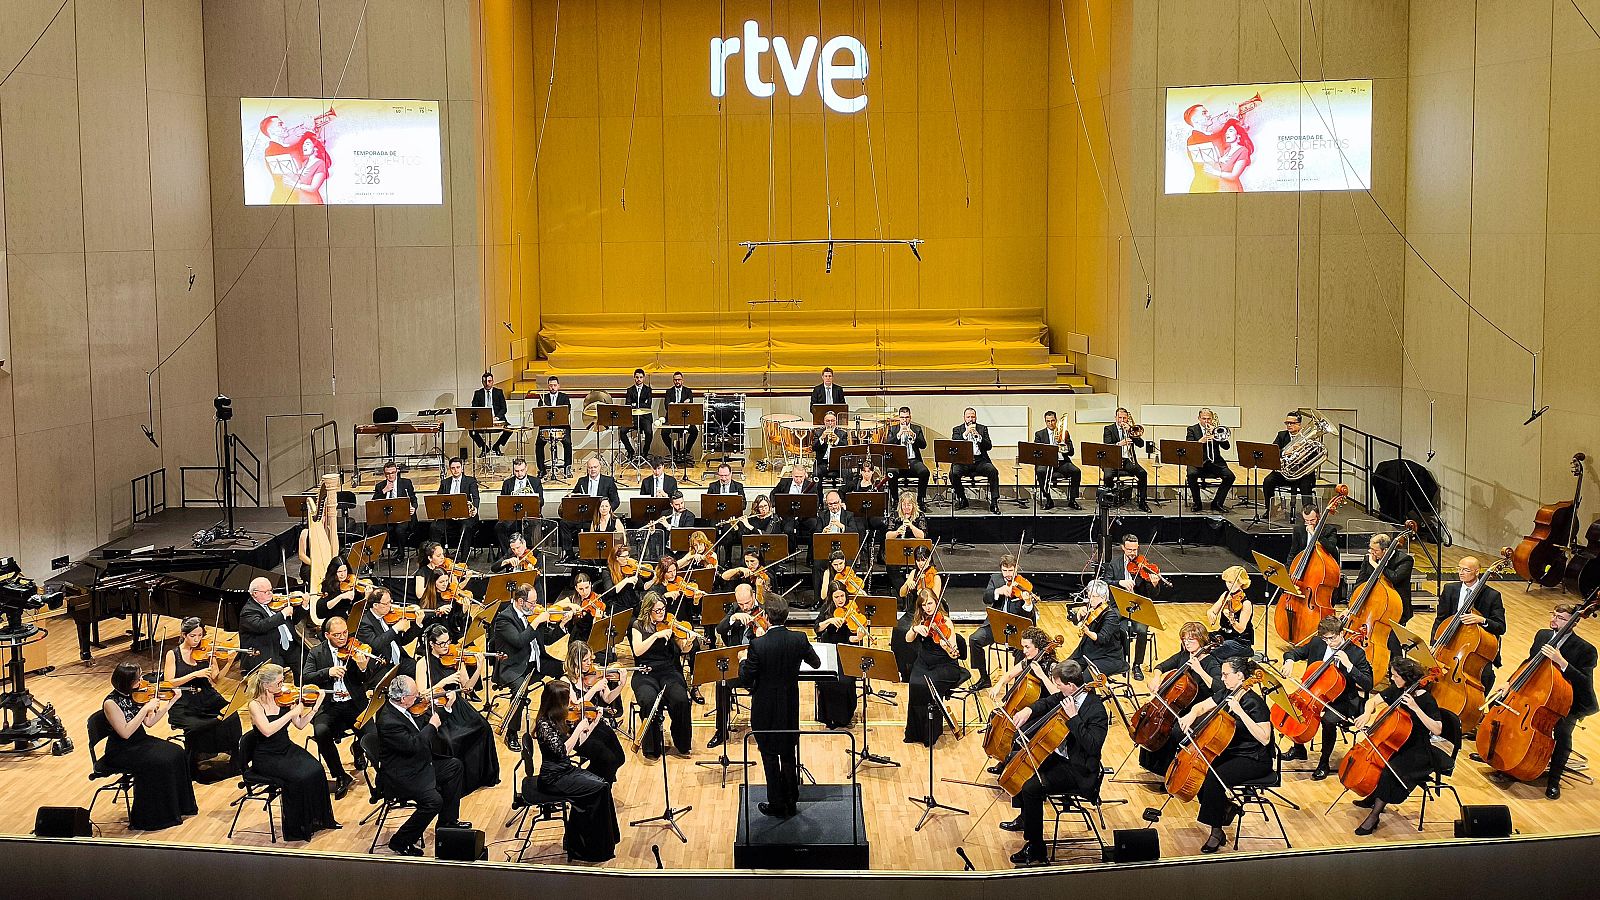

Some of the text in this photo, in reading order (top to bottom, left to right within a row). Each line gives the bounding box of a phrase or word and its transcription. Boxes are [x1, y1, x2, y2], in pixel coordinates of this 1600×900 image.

[710, 19, 869, 114] rtve
[1277, 139, 1350, 150] CONCIERTOS
[1277, 151, 1304, 160] 2025
[1277, 161, 1304, 170] 2026
[354, 175, 380, 184] 2026
